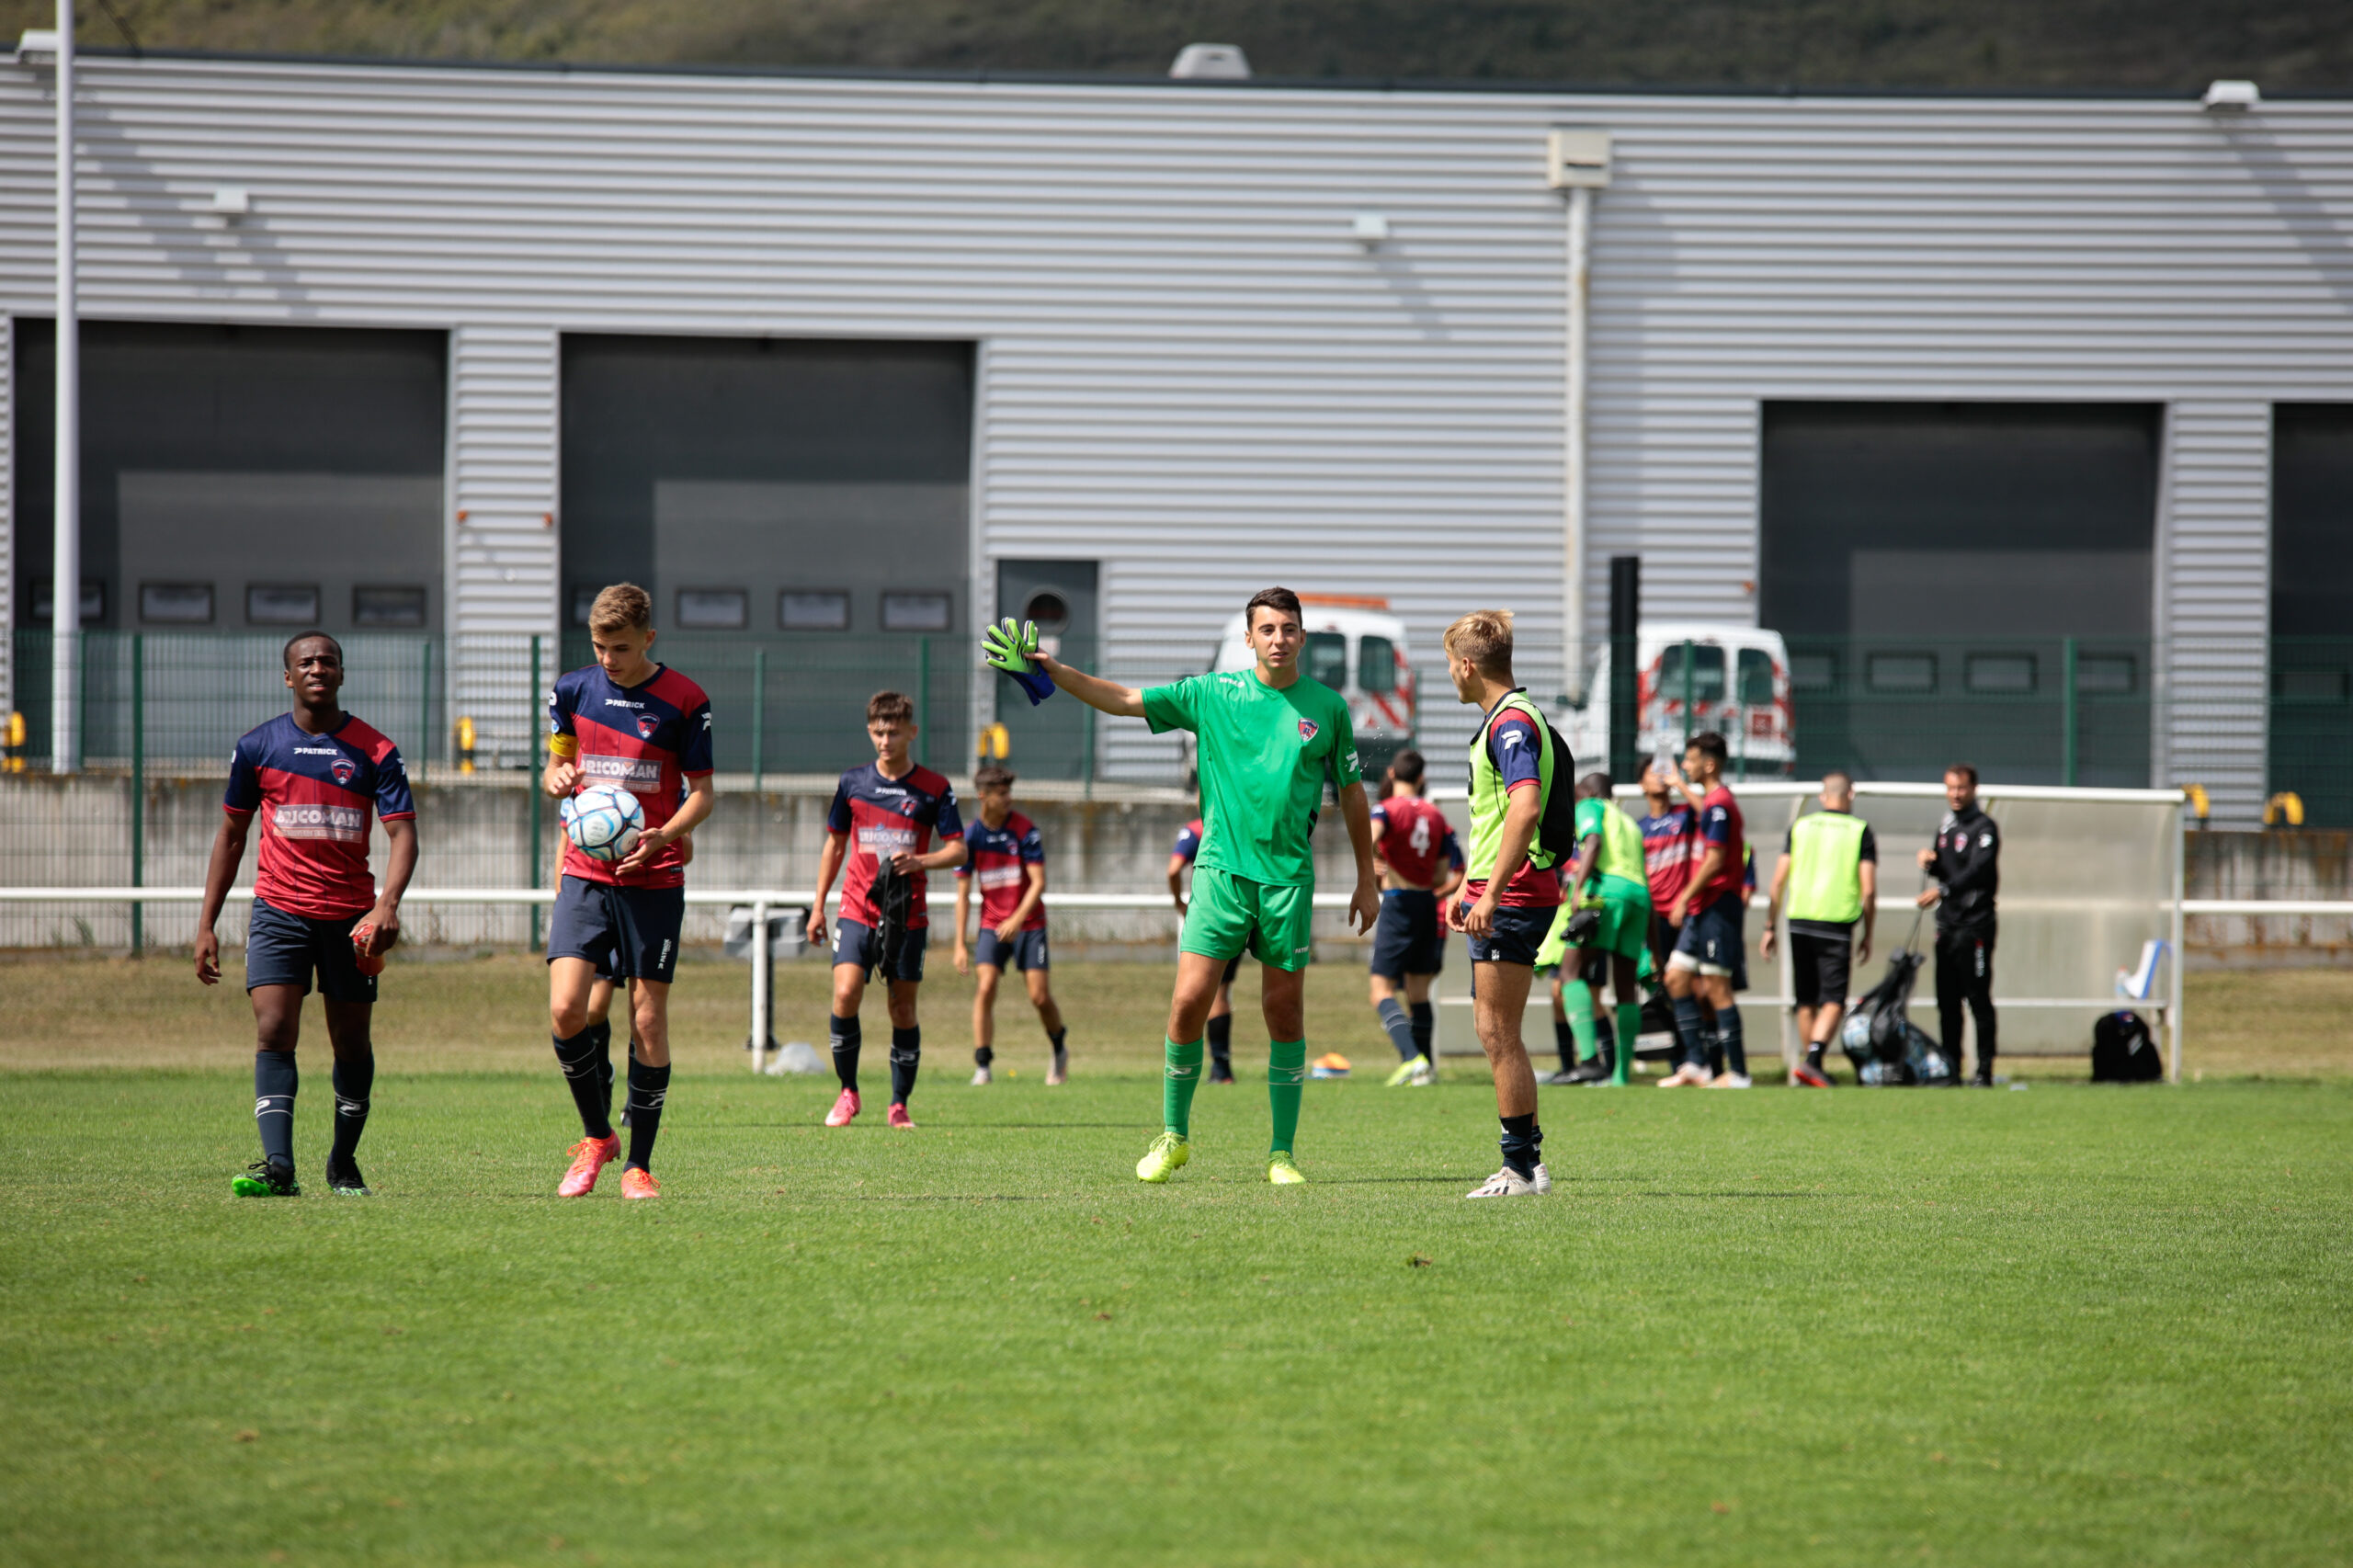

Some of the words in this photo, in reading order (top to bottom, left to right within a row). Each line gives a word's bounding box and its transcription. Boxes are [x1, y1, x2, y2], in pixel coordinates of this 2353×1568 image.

[613, 699, 645, 710] PATRICK
[302, 747, 338, 756] PATRICK
[1410, 815, 1430, 858] 4
